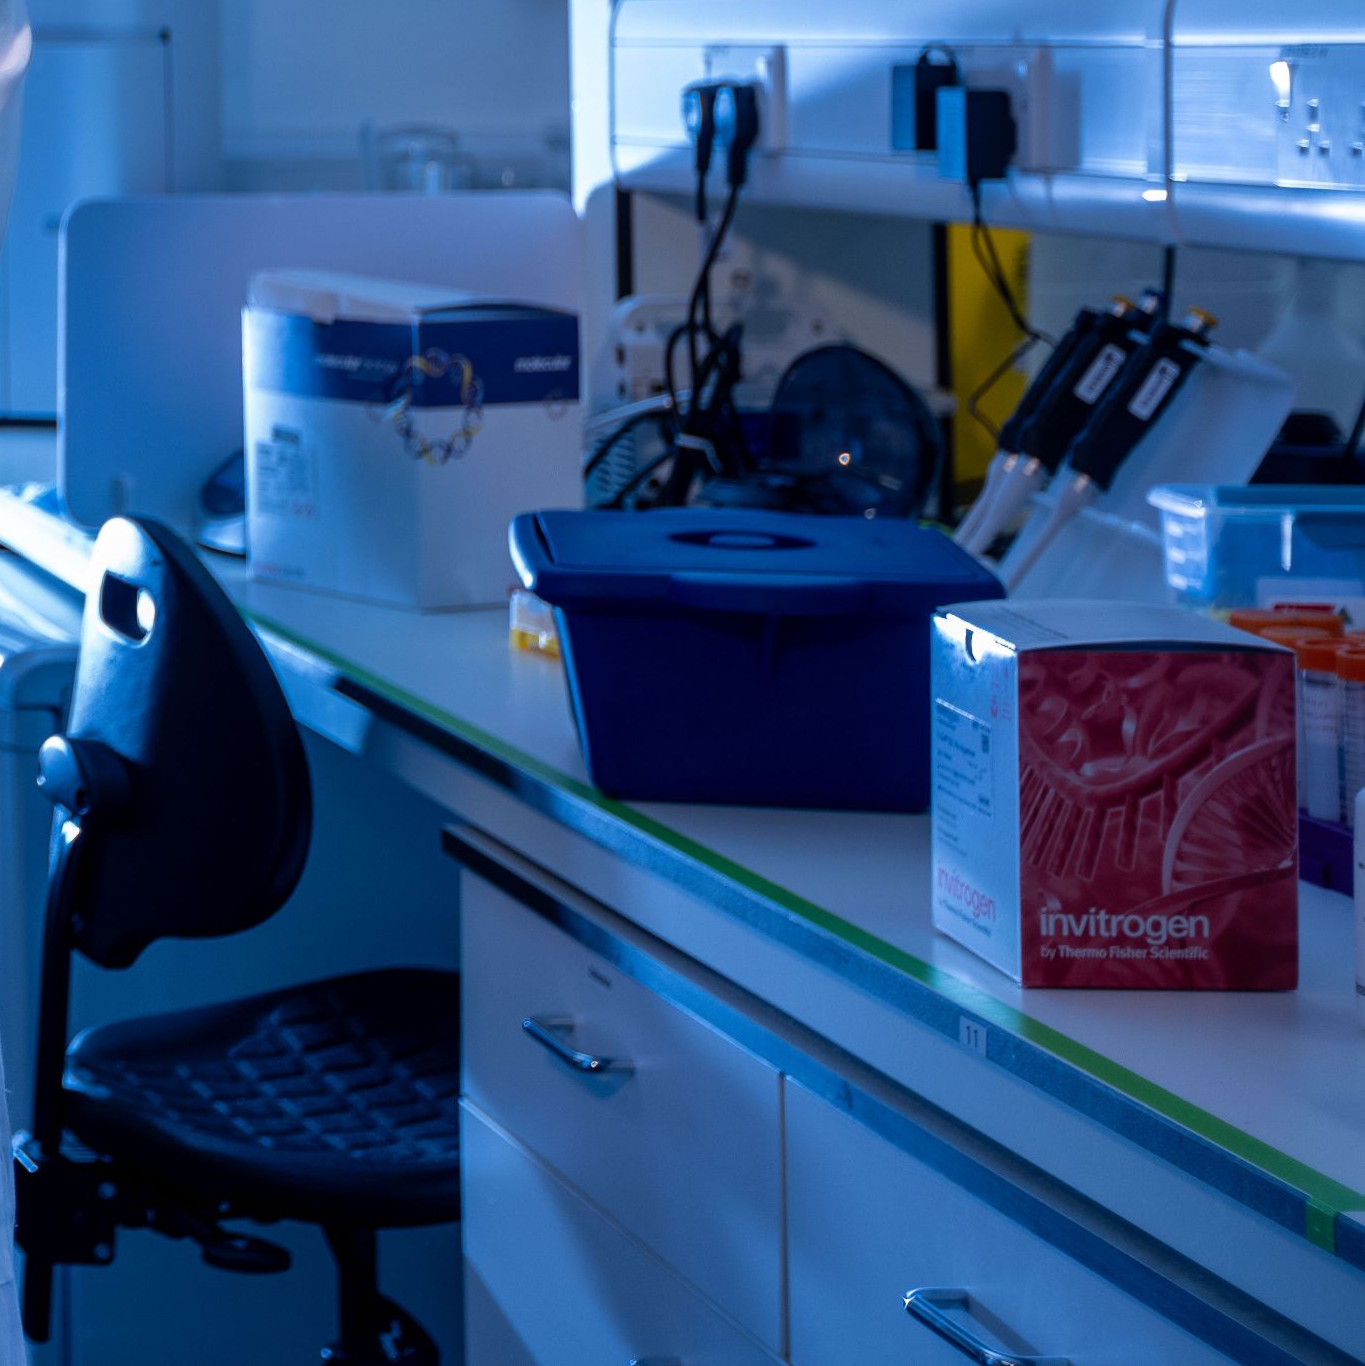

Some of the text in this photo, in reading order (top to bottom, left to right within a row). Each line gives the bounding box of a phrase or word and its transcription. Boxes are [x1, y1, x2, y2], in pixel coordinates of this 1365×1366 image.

[1040, 906, 1211, 946] invitrogen
[1041, 945, 1209, 960] by Thermo Fisher Scientific
[966, 1025, 979, 1049] 11
